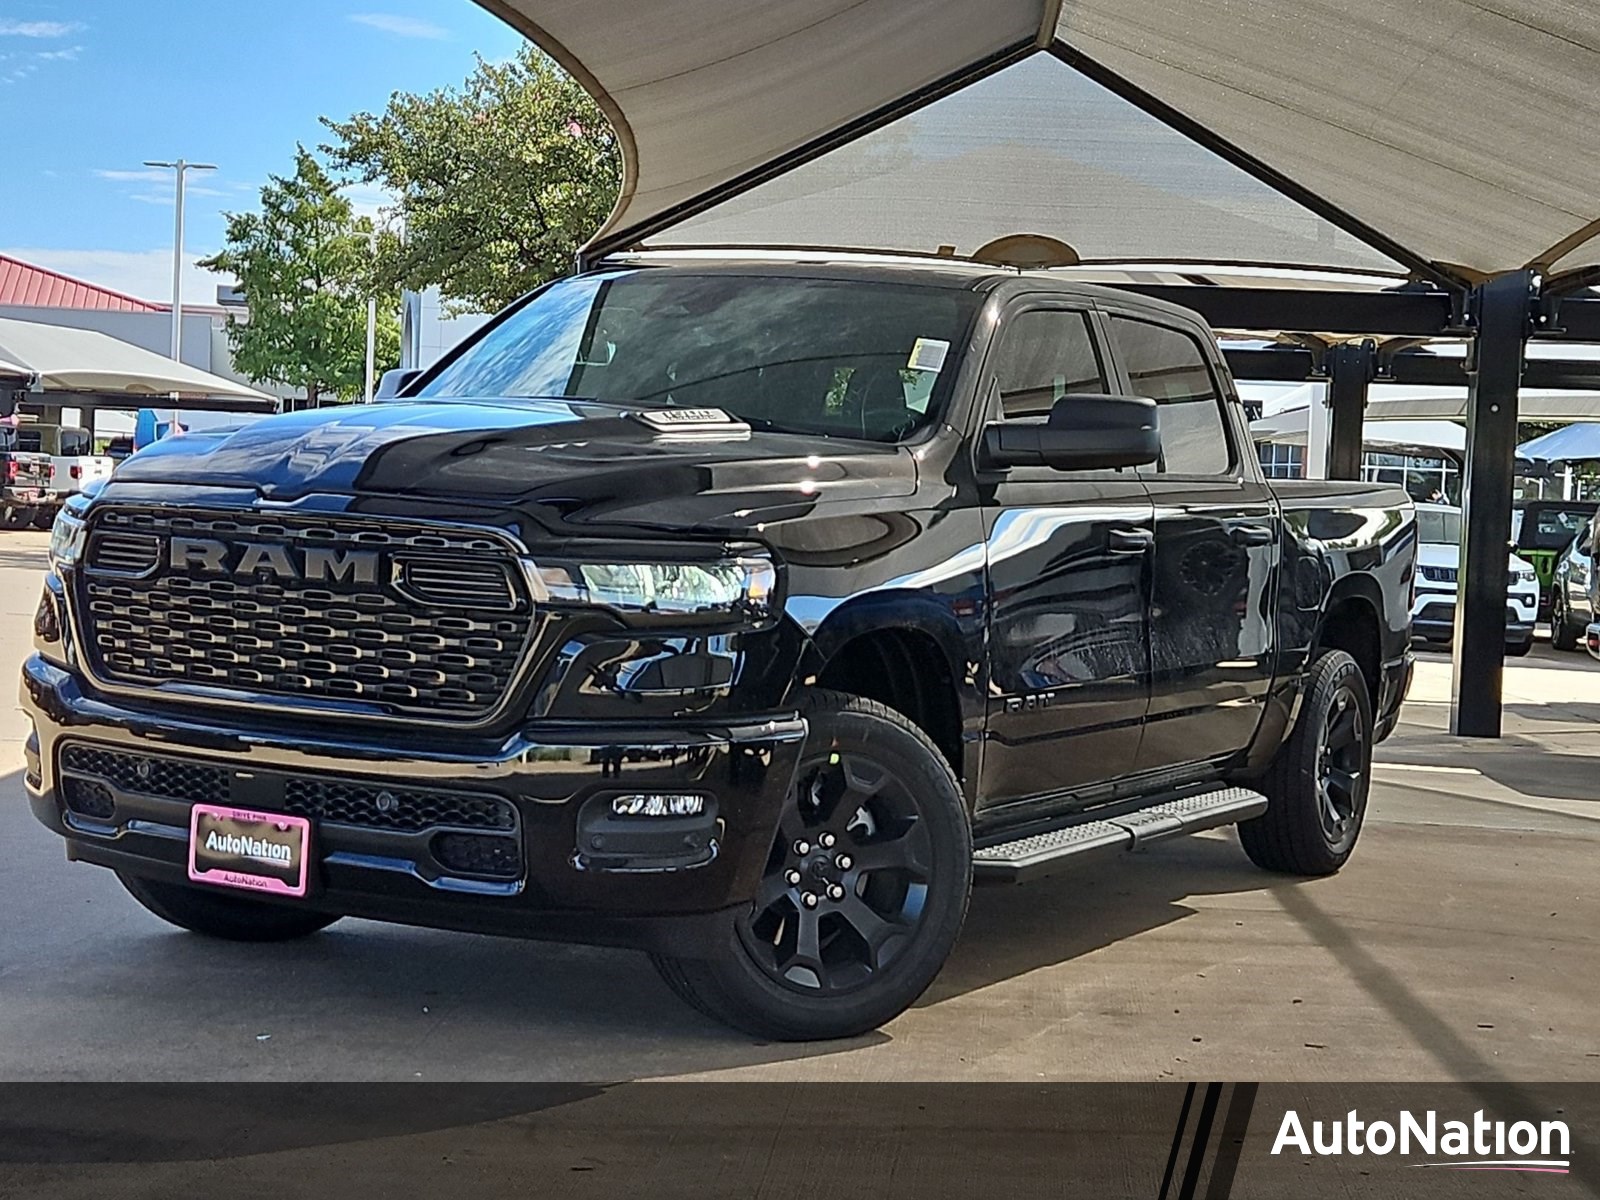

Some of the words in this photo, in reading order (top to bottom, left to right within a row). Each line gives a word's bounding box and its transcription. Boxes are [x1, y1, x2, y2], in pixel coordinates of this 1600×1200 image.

[170, 536, 379, 585] RAM
[205, 830, 292, 860] AutoNation
[223, 873, 268, 888] AutoNation
